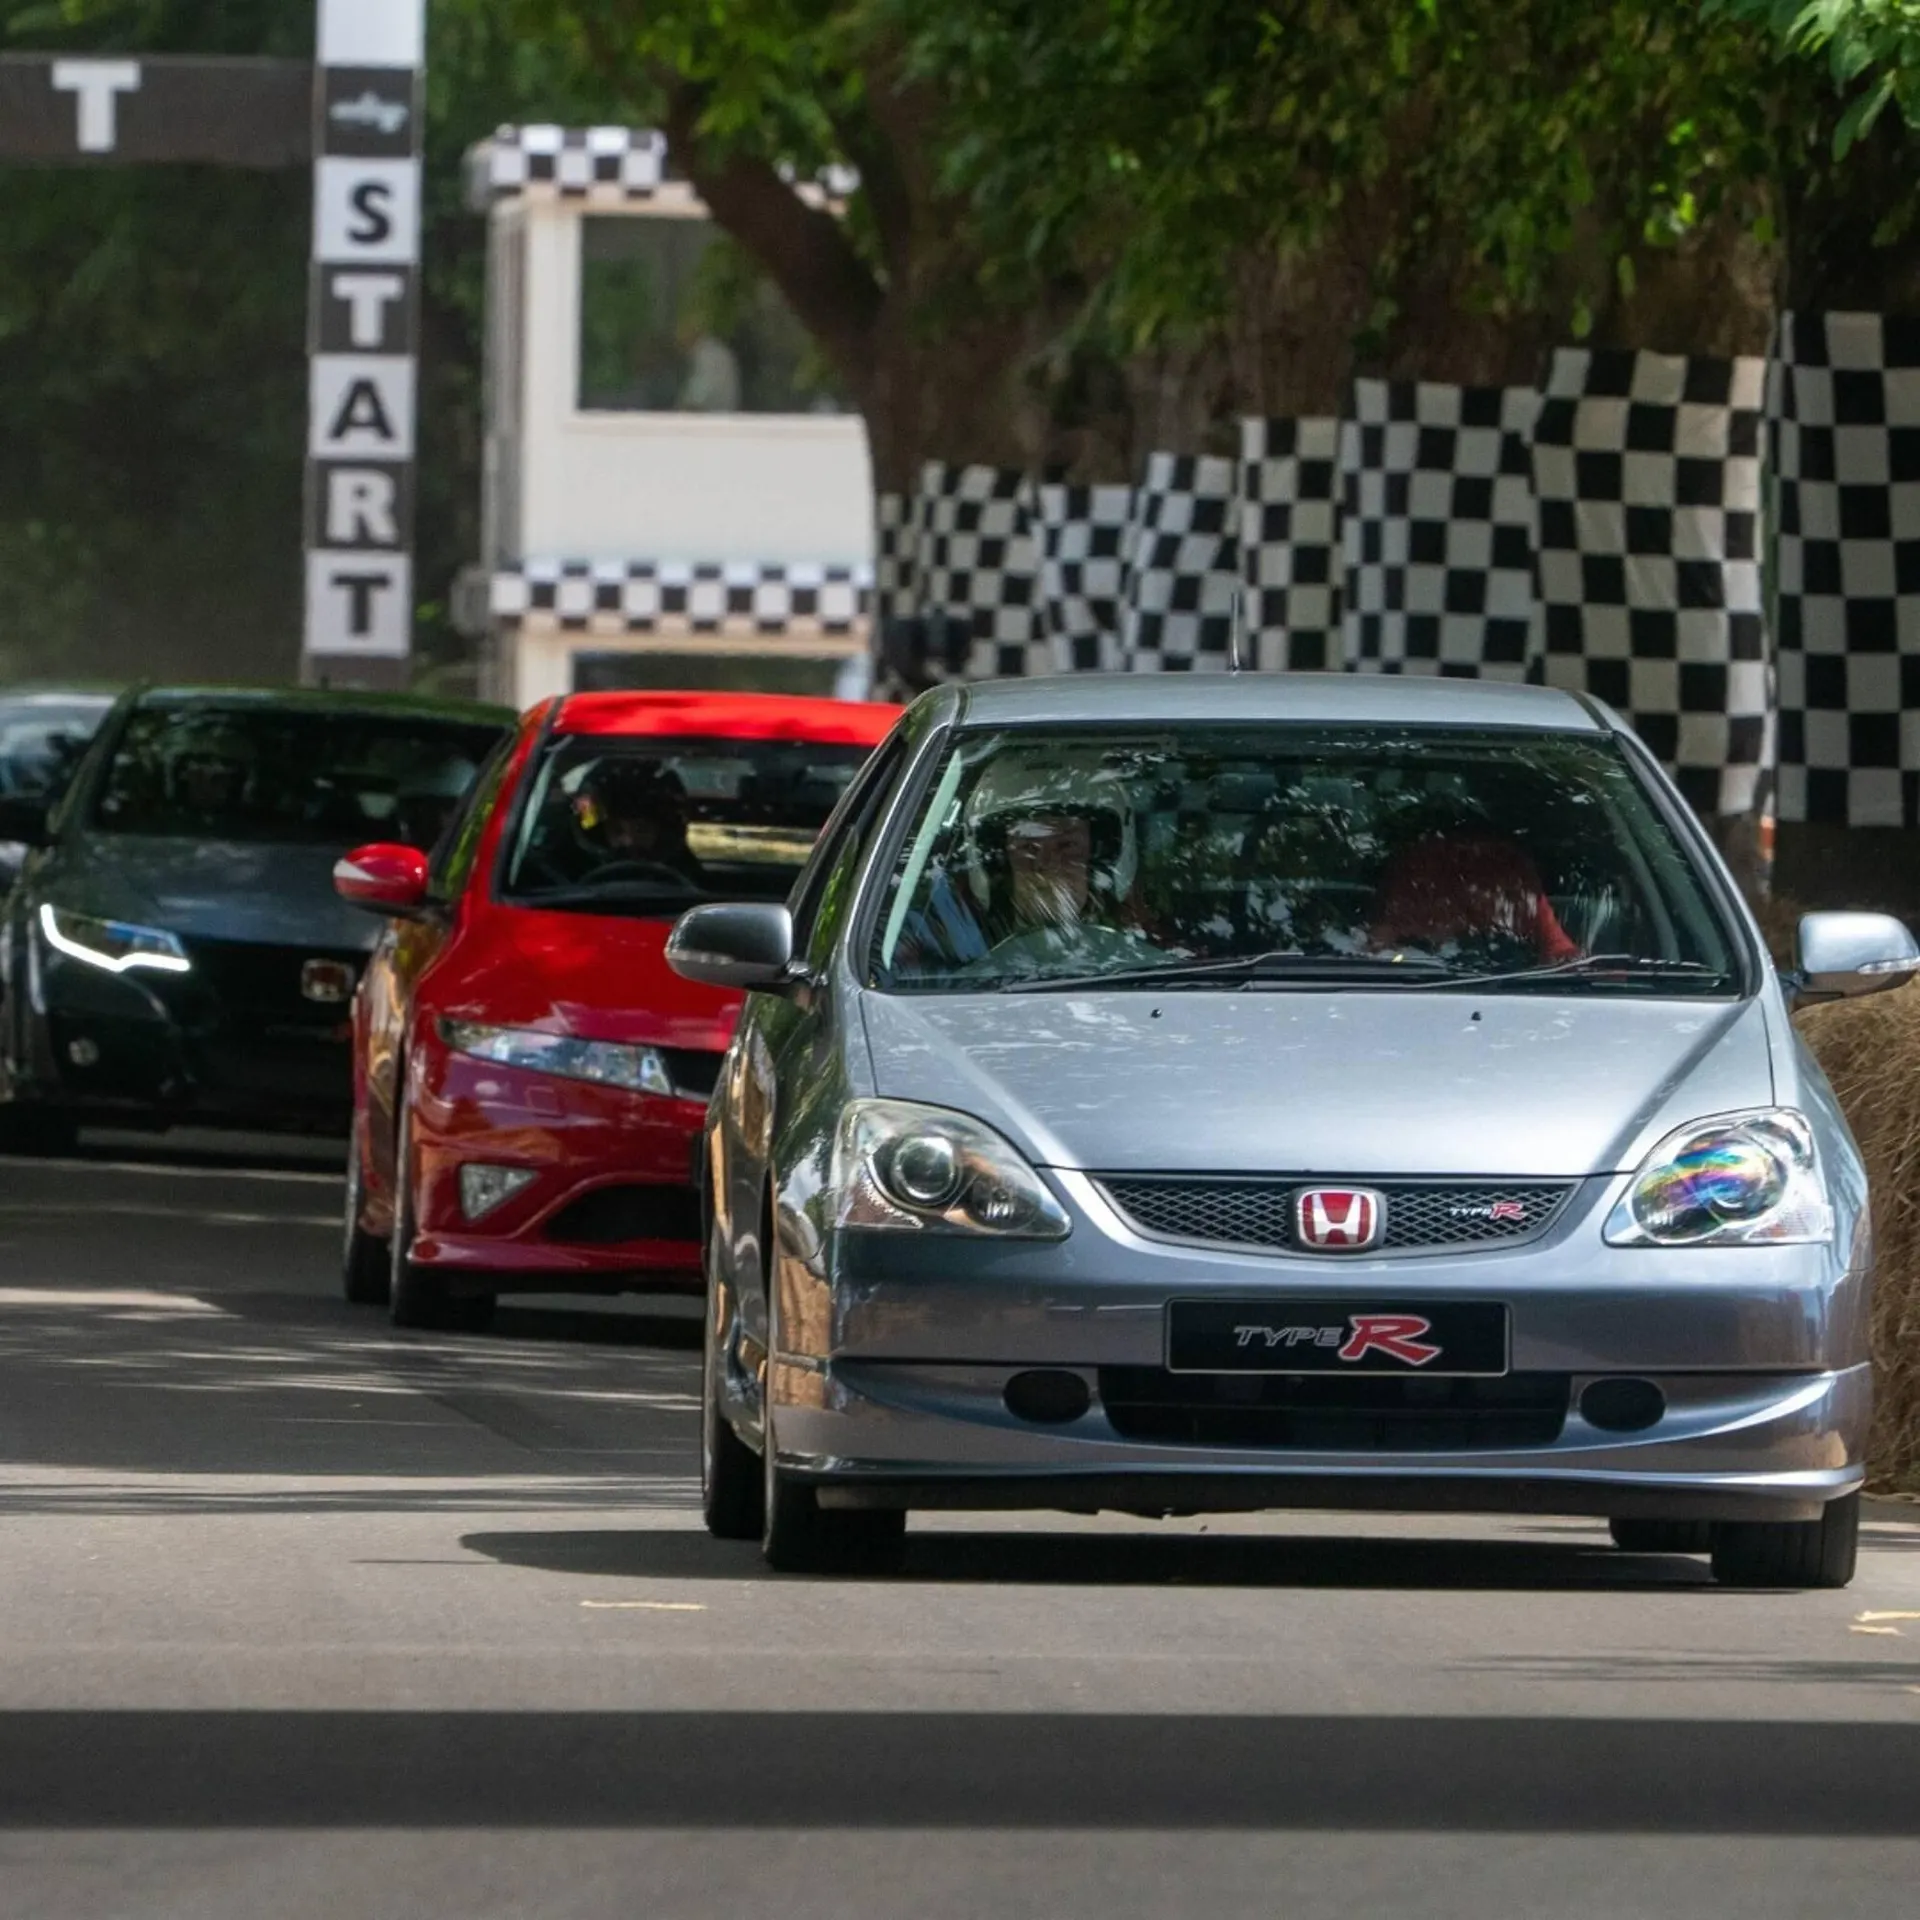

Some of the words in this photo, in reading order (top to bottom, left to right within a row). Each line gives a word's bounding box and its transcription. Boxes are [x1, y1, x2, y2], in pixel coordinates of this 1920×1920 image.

[52, 59, 141, 152] T
[327, 182, 404, 637] START
[1448, 1207, 1492, 1217] TYPE
[1488, 1202, 1528, 1221] R
[1234, 1325, 1344, 1347] TYPE
[1337, 1313, 1443, 1367] R
